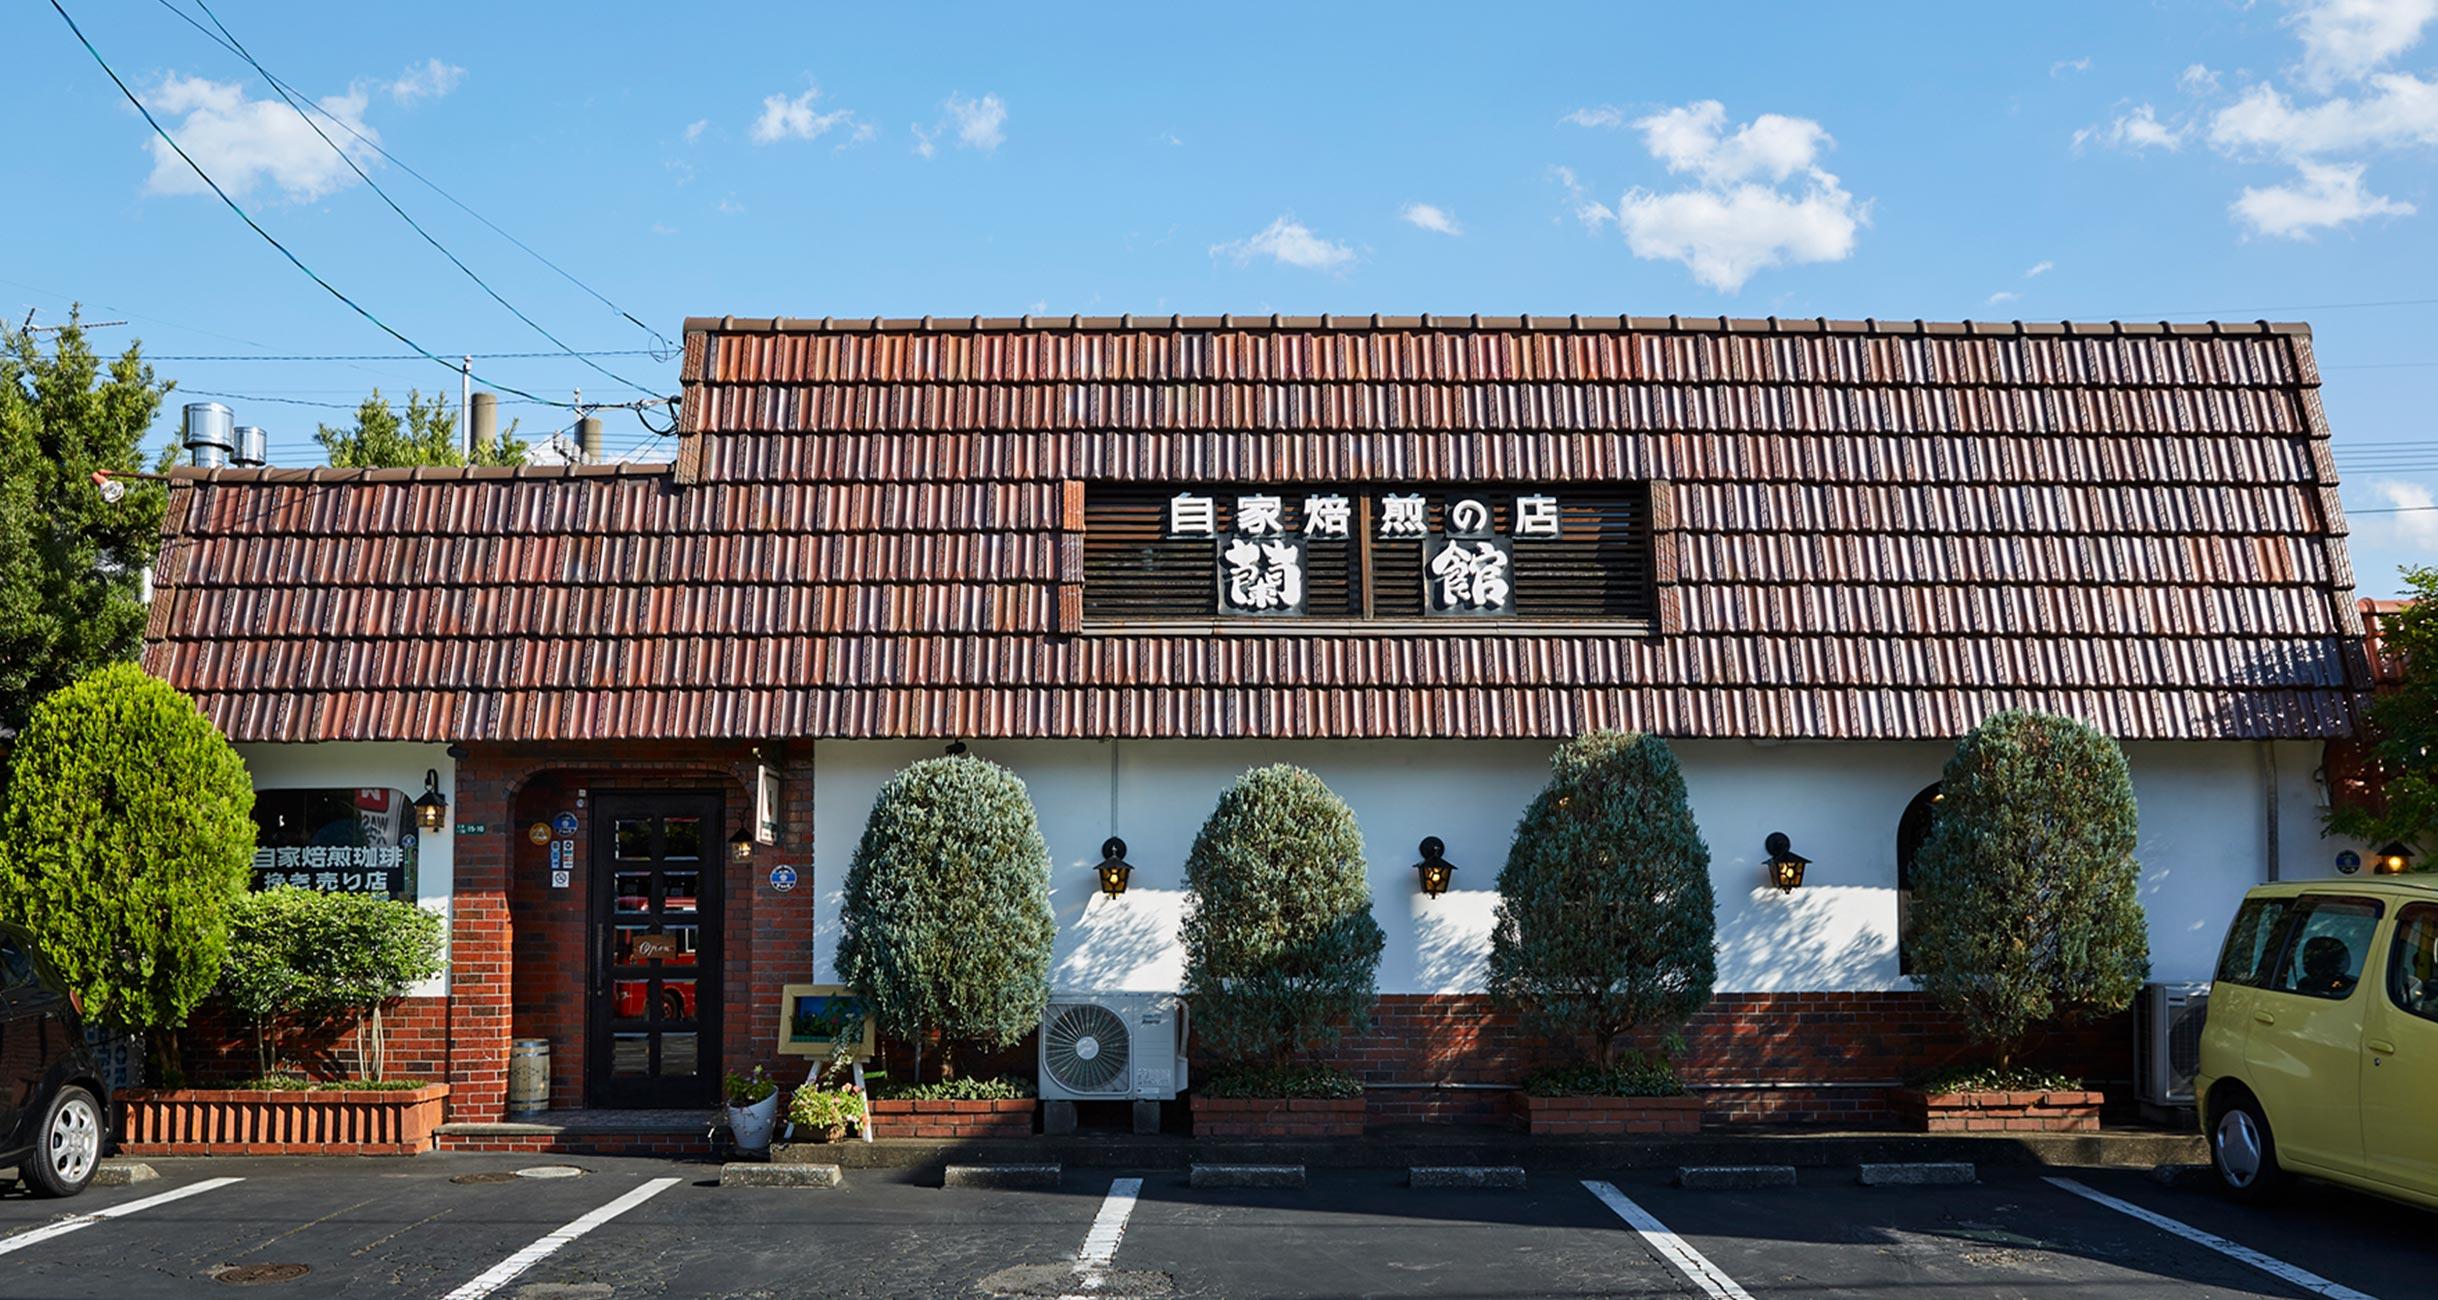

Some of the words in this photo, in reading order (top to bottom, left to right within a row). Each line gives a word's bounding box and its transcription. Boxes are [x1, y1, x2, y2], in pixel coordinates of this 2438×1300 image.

[1169, 493, 1560, 535] 自家焙煎の店
[252, 846, 403, 868] 自家焙煎珈琲
